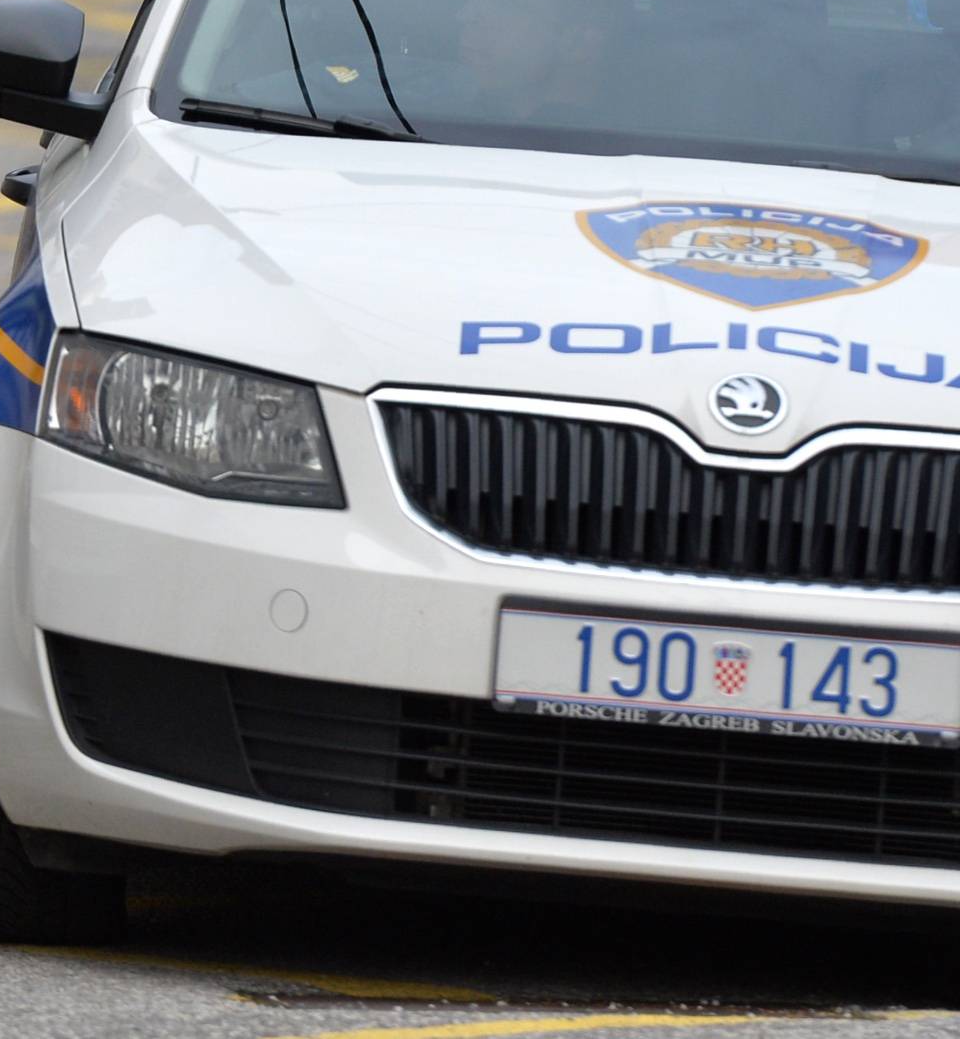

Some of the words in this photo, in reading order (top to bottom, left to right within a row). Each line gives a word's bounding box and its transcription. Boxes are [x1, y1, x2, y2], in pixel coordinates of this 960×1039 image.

[605, 206, 905, 247] POLICIJA
[460, 321, 960, 388] POLICIJ
[577, 624, 697, 702] 190
[778, 640, 898, 718] 143
[534, 700, 649, 724] PORSCHE
[658, 712, 761, 733] ZAGREB
[771, 722, 920, 746] SLAVONSKA
